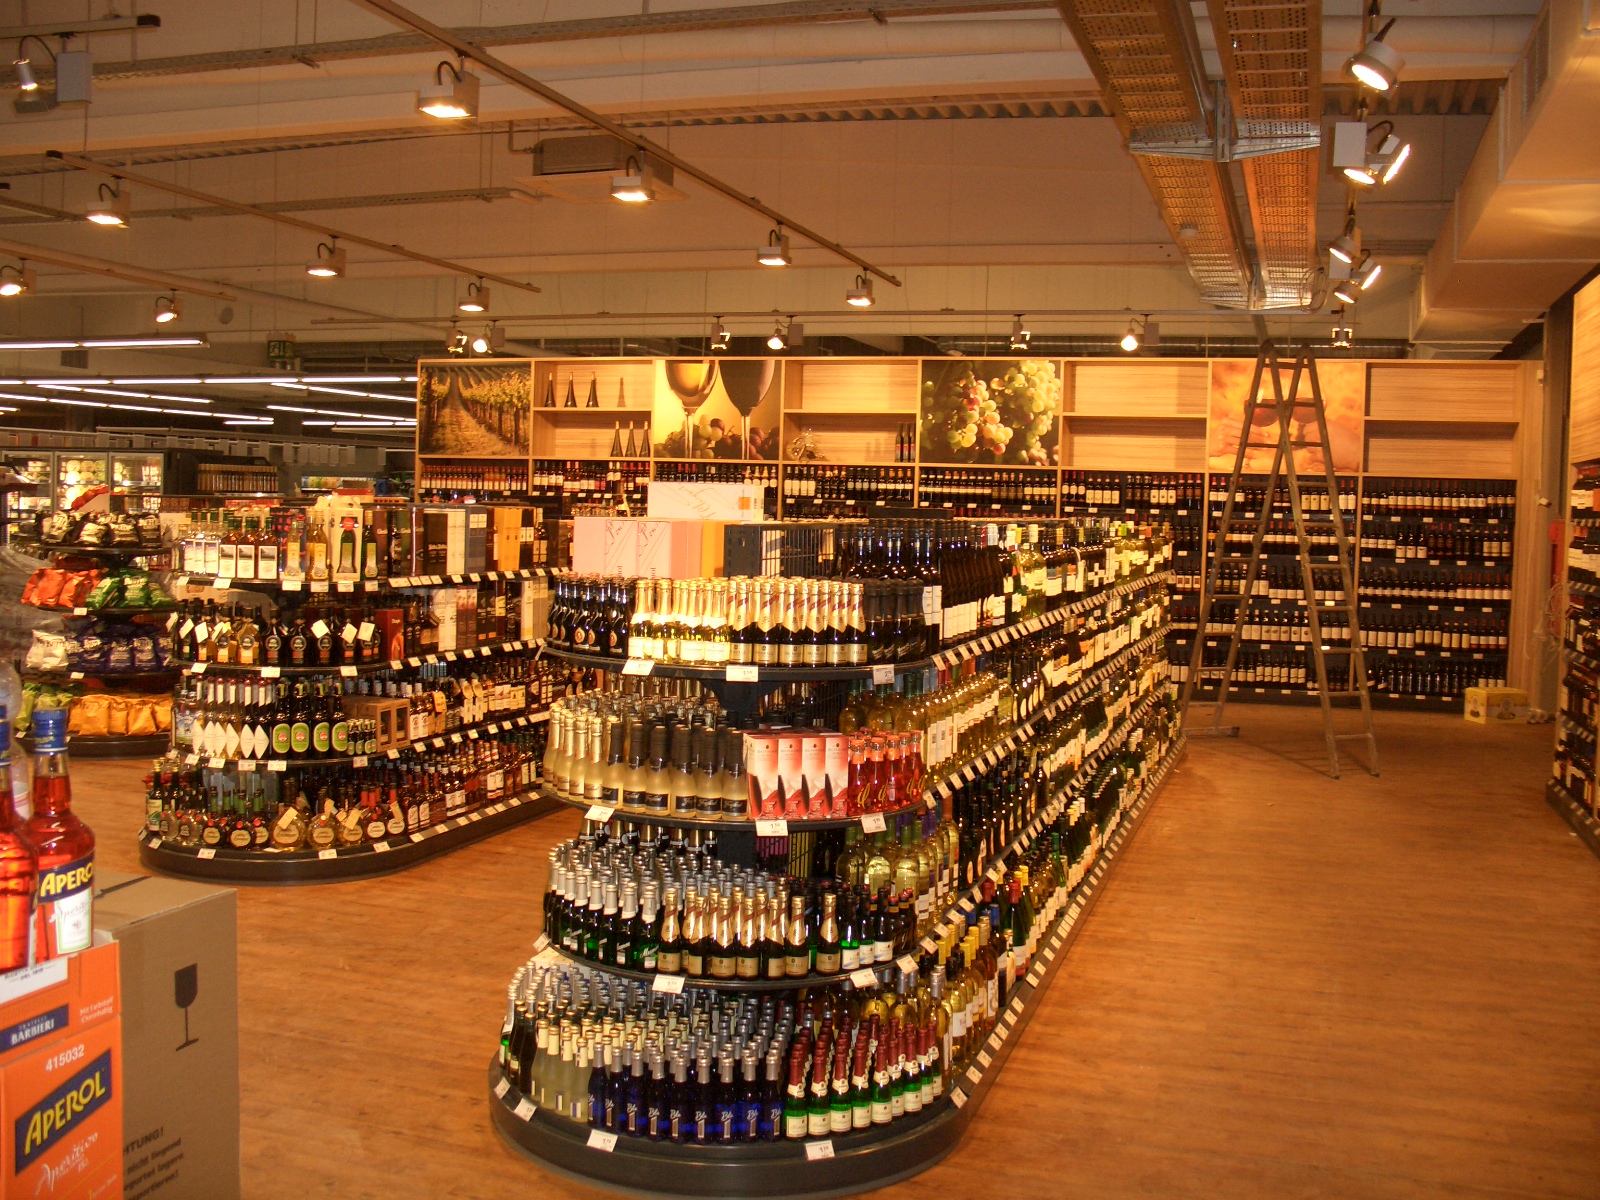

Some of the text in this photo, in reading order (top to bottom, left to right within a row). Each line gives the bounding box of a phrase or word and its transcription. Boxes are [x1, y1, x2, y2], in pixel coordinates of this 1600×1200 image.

[11, 1018, 55, 1046] BARBIERI
[45, 1044, 85, 1072] 415032
[24, 1071, 106, 1156] APEROL
